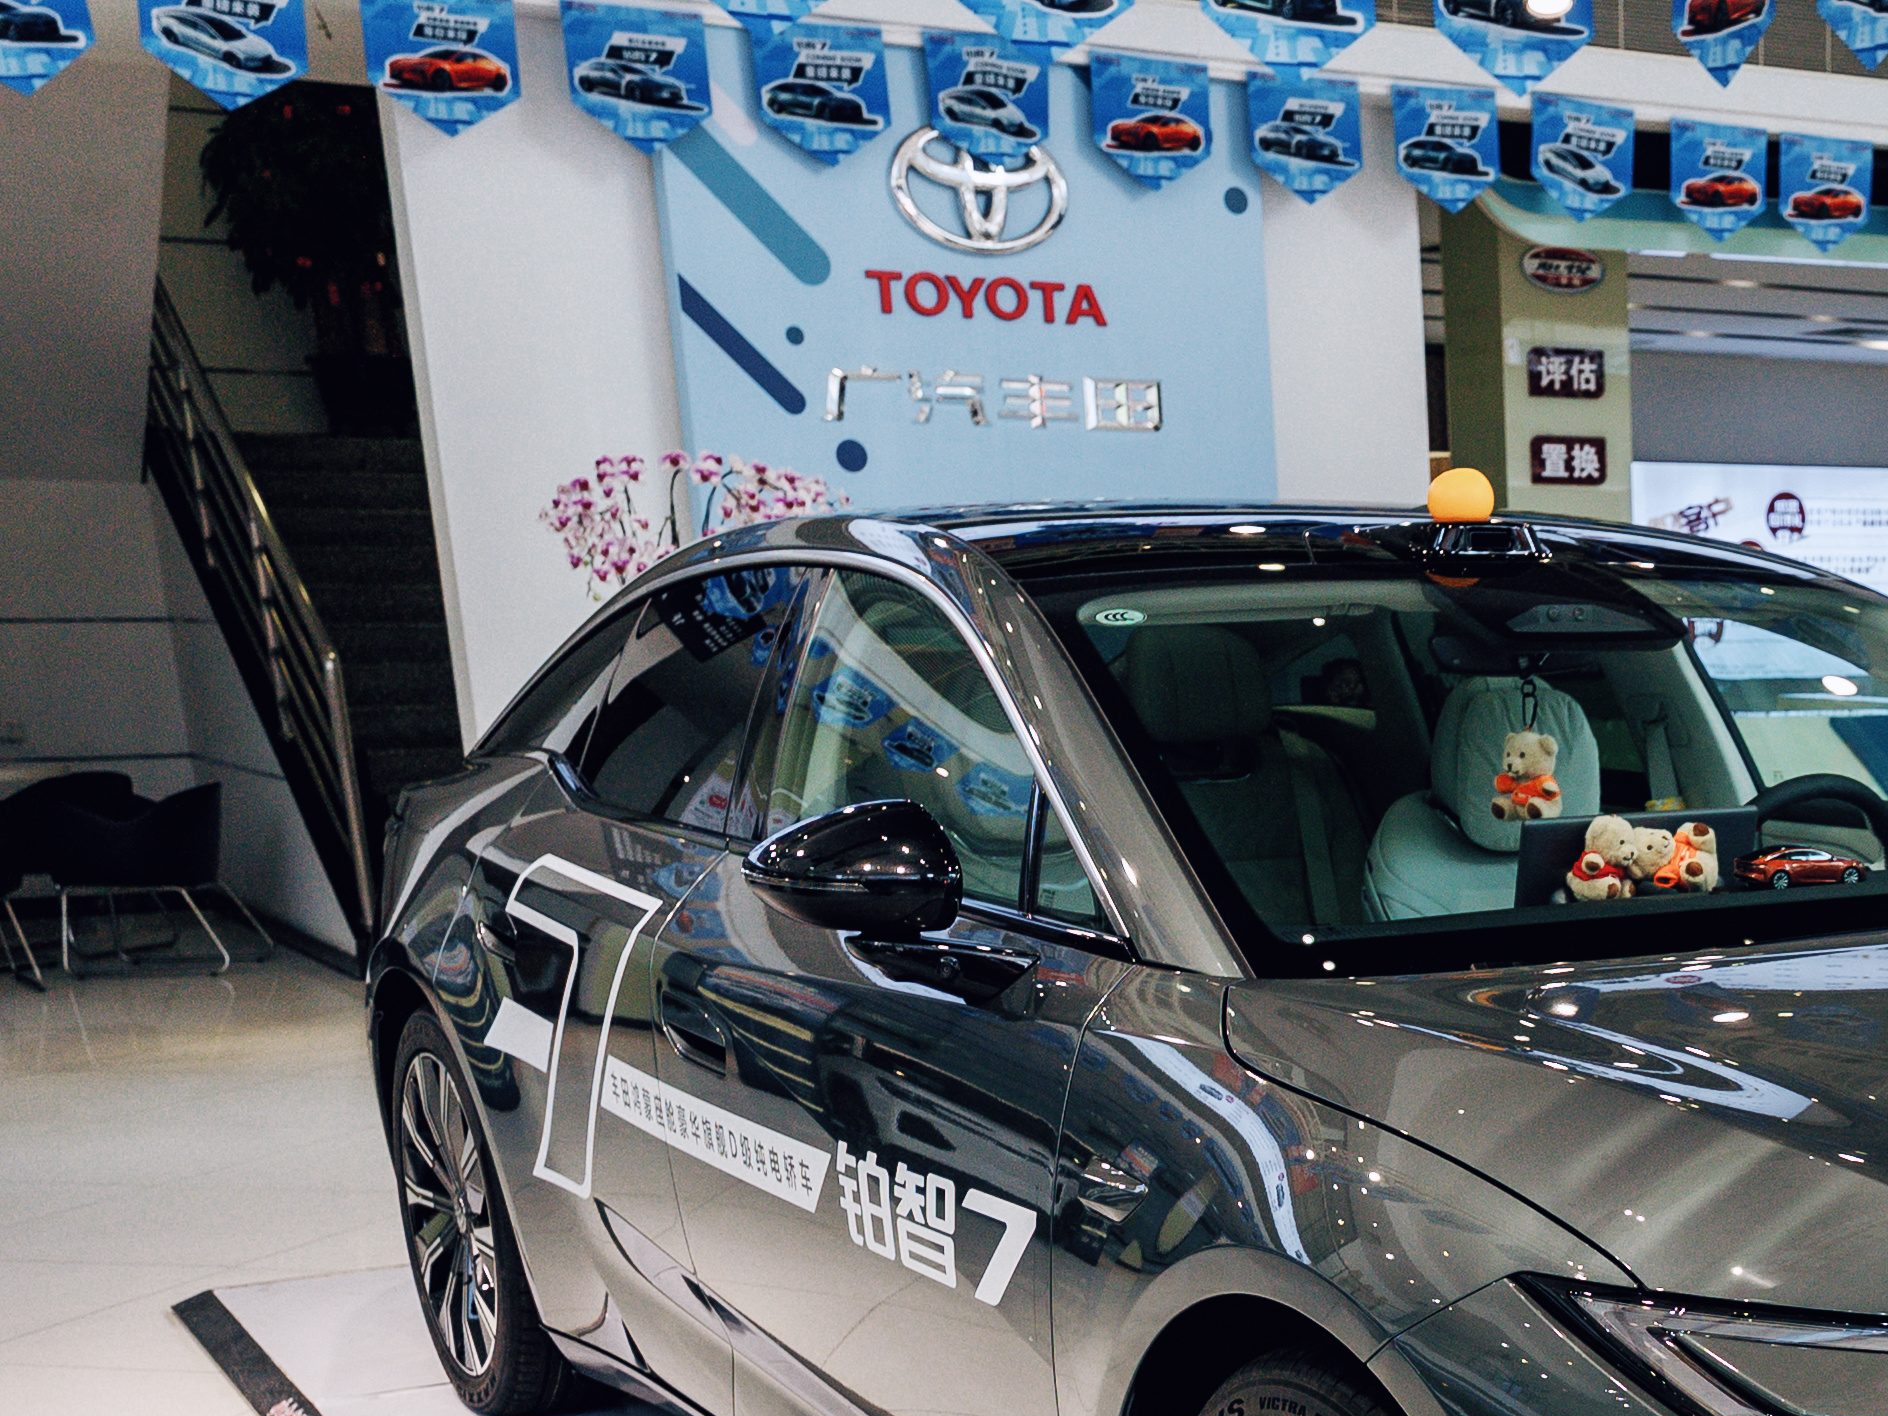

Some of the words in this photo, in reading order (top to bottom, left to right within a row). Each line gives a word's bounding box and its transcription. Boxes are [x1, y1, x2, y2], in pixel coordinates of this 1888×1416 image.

[866, 269, 1107, 327] TOYOTA
[822, 366, 1163, 432] 广汽丰田
[1537, 354, 1598, 392] 评估
[1540, 443, 1601, 480] 置换
[835, 1140, 1037, 1306] 铂智7
